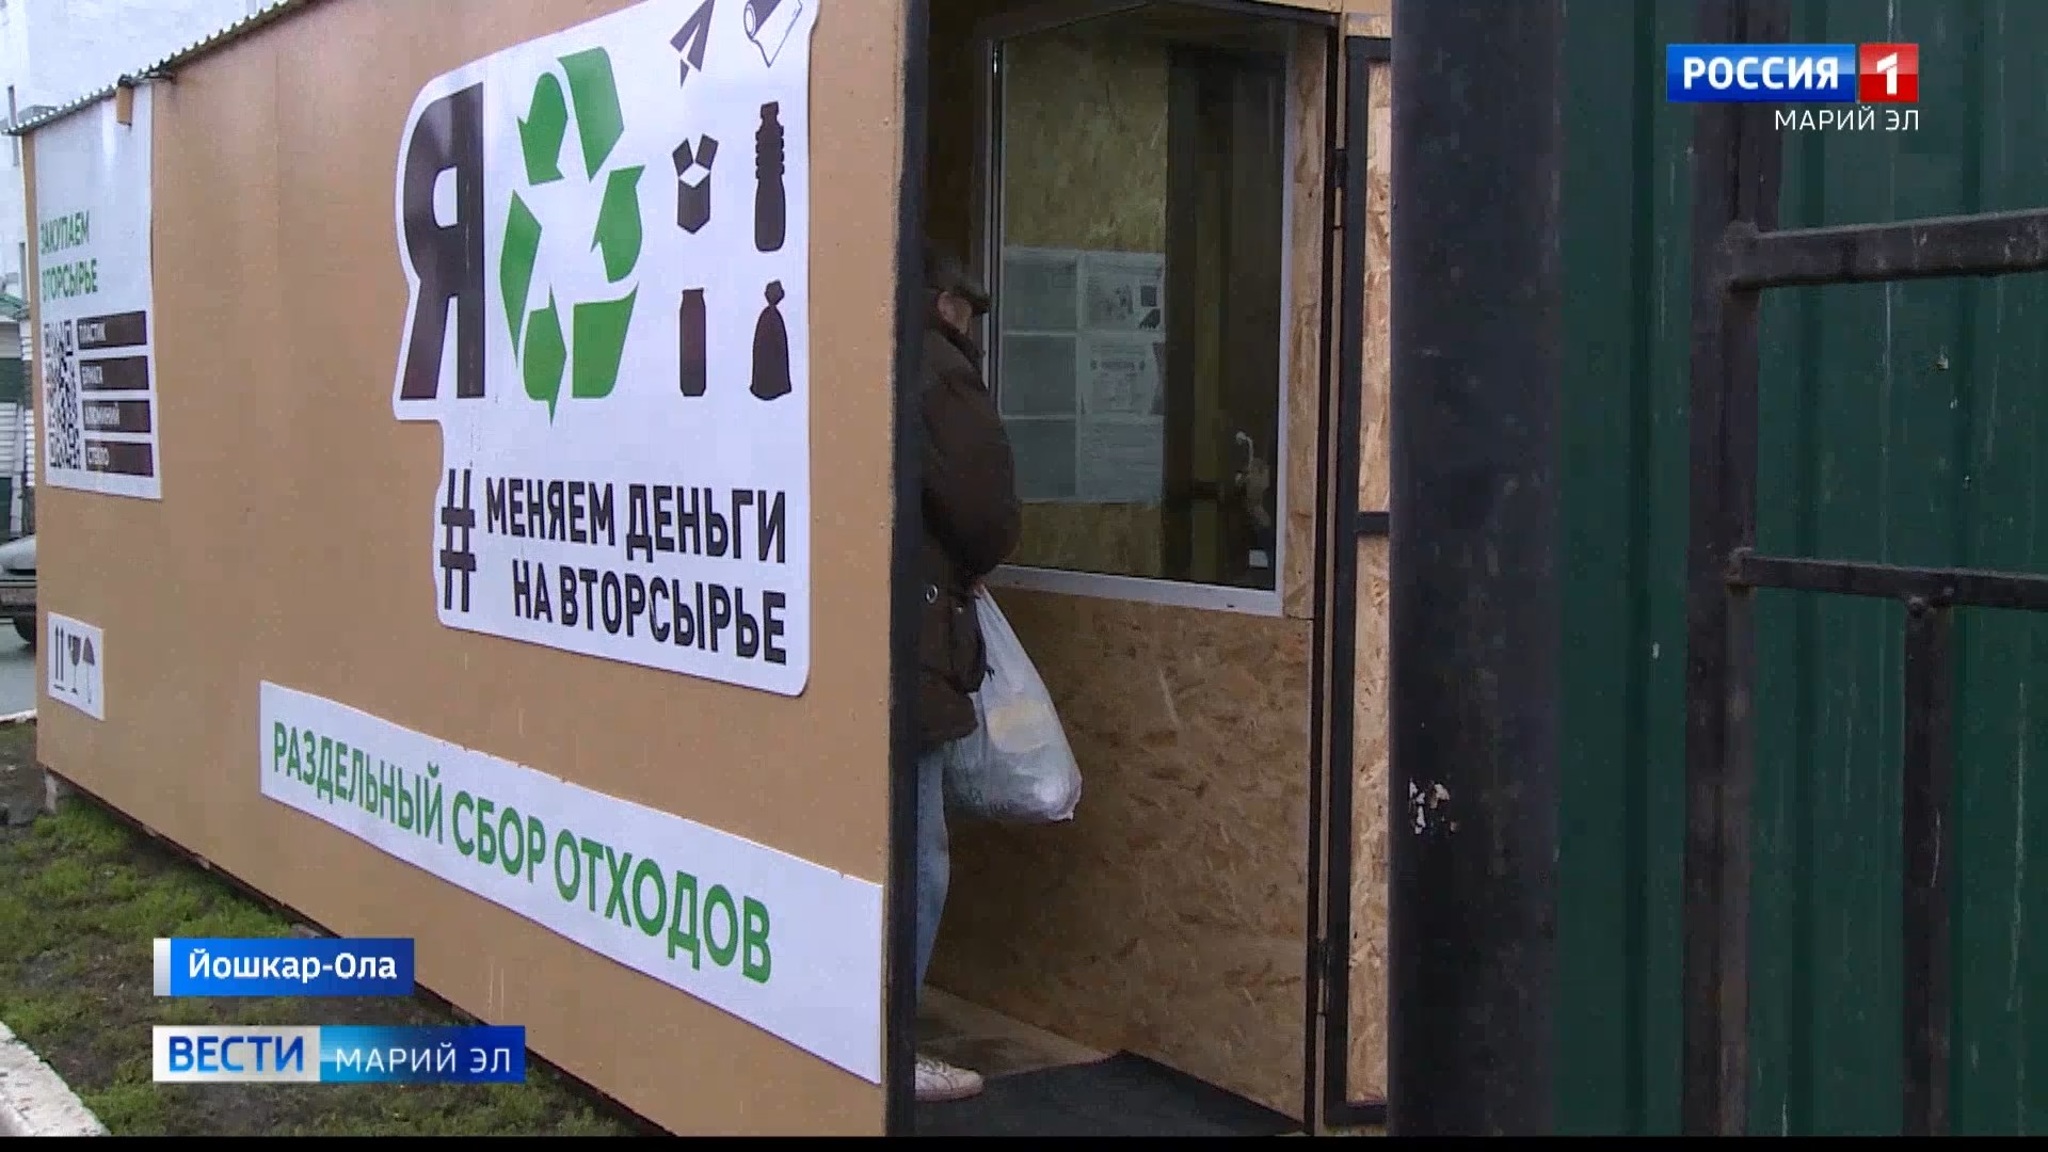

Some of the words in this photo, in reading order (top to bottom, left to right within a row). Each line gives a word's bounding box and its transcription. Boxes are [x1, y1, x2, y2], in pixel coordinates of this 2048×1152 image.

[41, 209, 90, 255] ЗАКУПАЕМ
[400, 82, 486, 400] Я
[486, 477, 616, 547] МЕНЯЕМ
[626, 483, 787, 564] ДЕНЬГИ
[512, 558, 553, 624] НА
[559, 564, 787, 666] ВТОРСЫРЬЕ
[273, 721, 444, 845] РАЗДЕЛЬНЫЙ
[452, 790, 547, 884] СБОР
[554, 828, 772, 985] ОТХОДОВ
